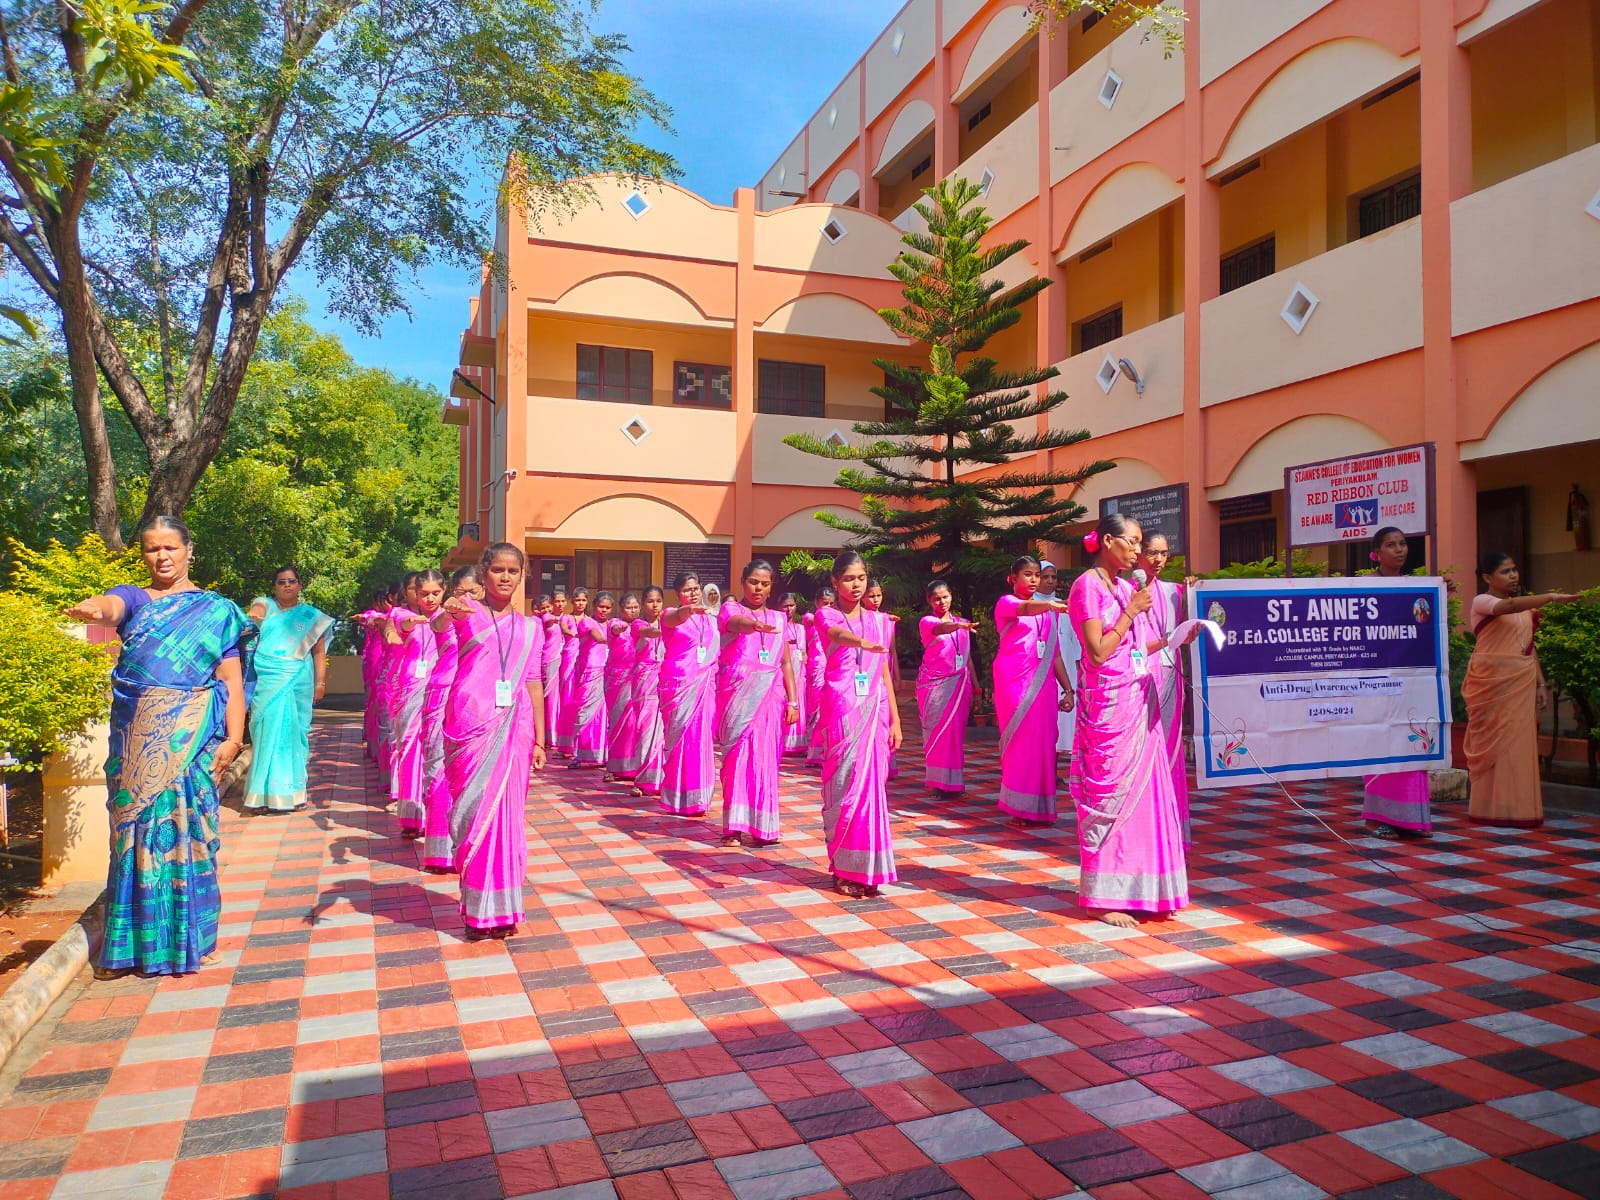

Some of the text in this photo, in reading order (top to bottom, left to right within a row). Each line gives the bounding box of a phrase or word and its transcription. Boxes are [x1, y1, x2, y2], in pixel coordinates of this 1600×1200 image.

[1320, 464, 1342, 478] COLLEGE
[1342, 462, 1350, 474] OF
[1351, 456, 1384, 473] EDUCATION
[1384, 455, 1396, 467] FOR
[1396, 451, 1421, 465] WOMEN
[1330, 472, 1378, 487] PERIYAKULAM
[1307, 479, 1409, 506] RED RIBBON CLUB
[1381, 502, 1415, 518] TAKE CARE
[1301, 513, 1334, 527] BE AWARE
[1342, 528, 1368, 539] AIDS
[1266, 597, 1379, 623] ST. ANNE'S
[1334, 626, 1361, 642] FOR
[1366, 625, 1417, 641] WOMEN
[1265, 680, 1403, 694] Anti-Drug Awareness Programme
